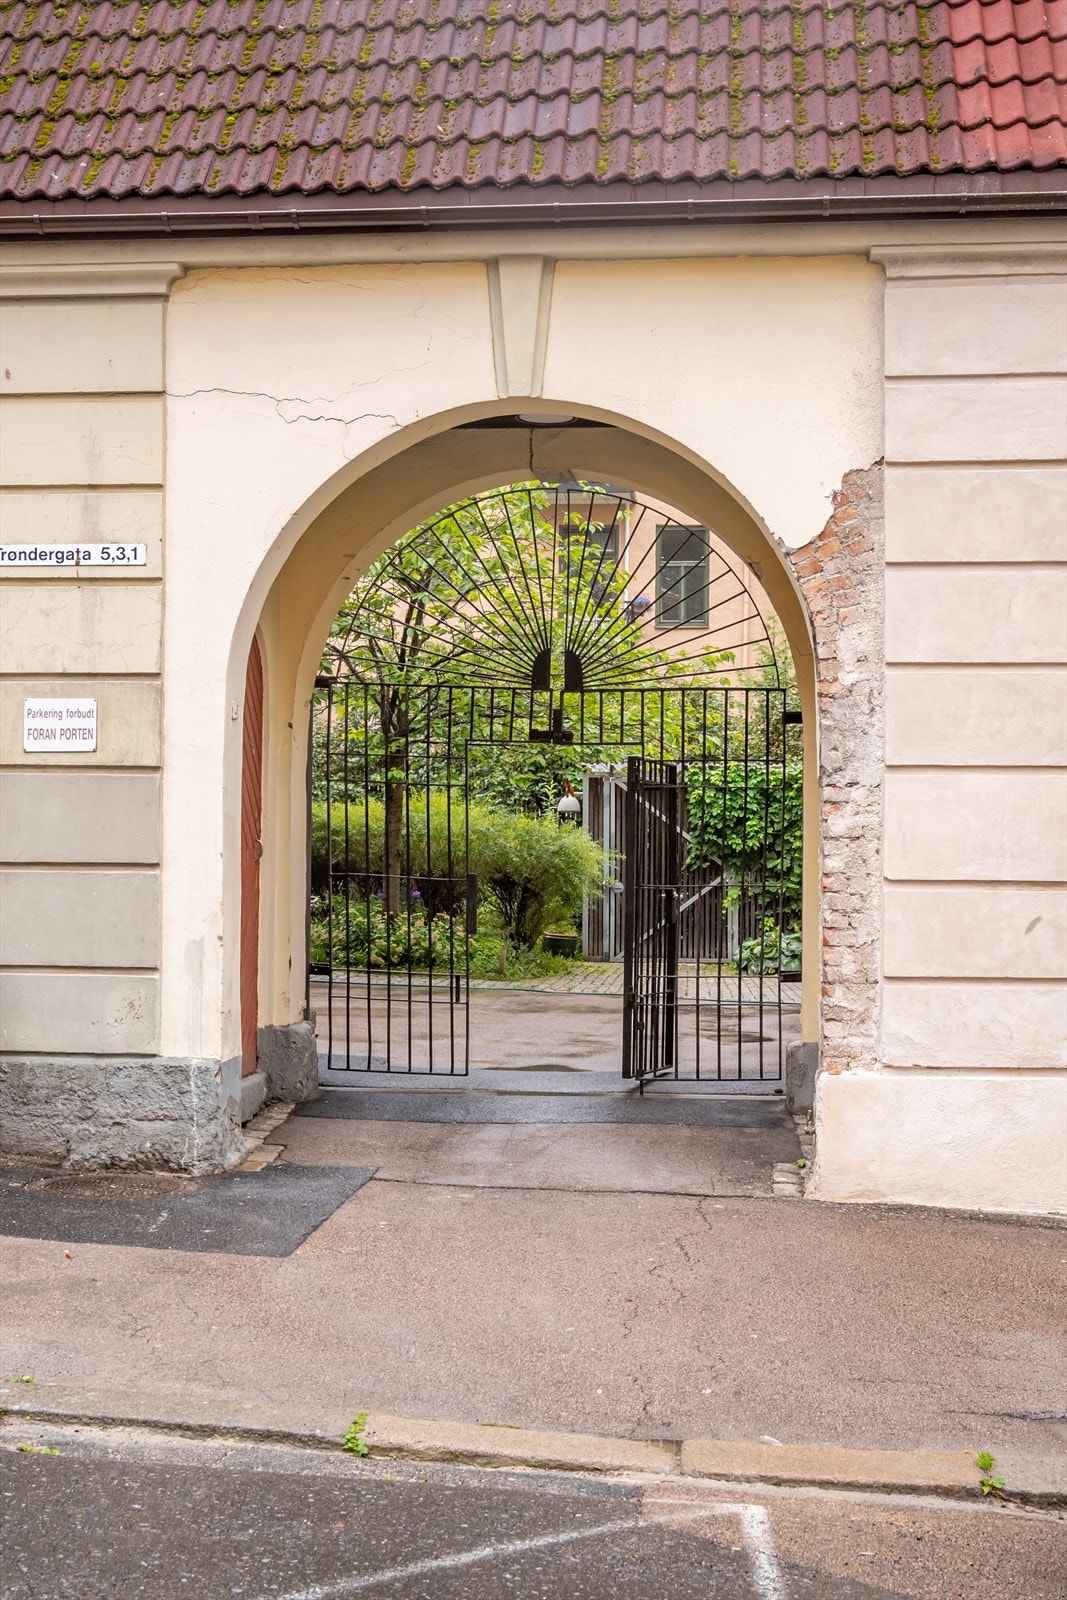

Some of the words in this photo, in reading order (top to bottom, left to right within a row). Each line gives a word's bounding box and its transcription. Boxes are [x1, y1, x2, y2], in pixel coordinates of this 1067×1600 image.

[100, 546, 138, 563] 5,3,1
[26, 708, 63, 721] Parkering
[66, 708, 95, 719] forbudt
[27, 728, 57, 740] FORAN
[60, 728, 94, 740] PORTEN
